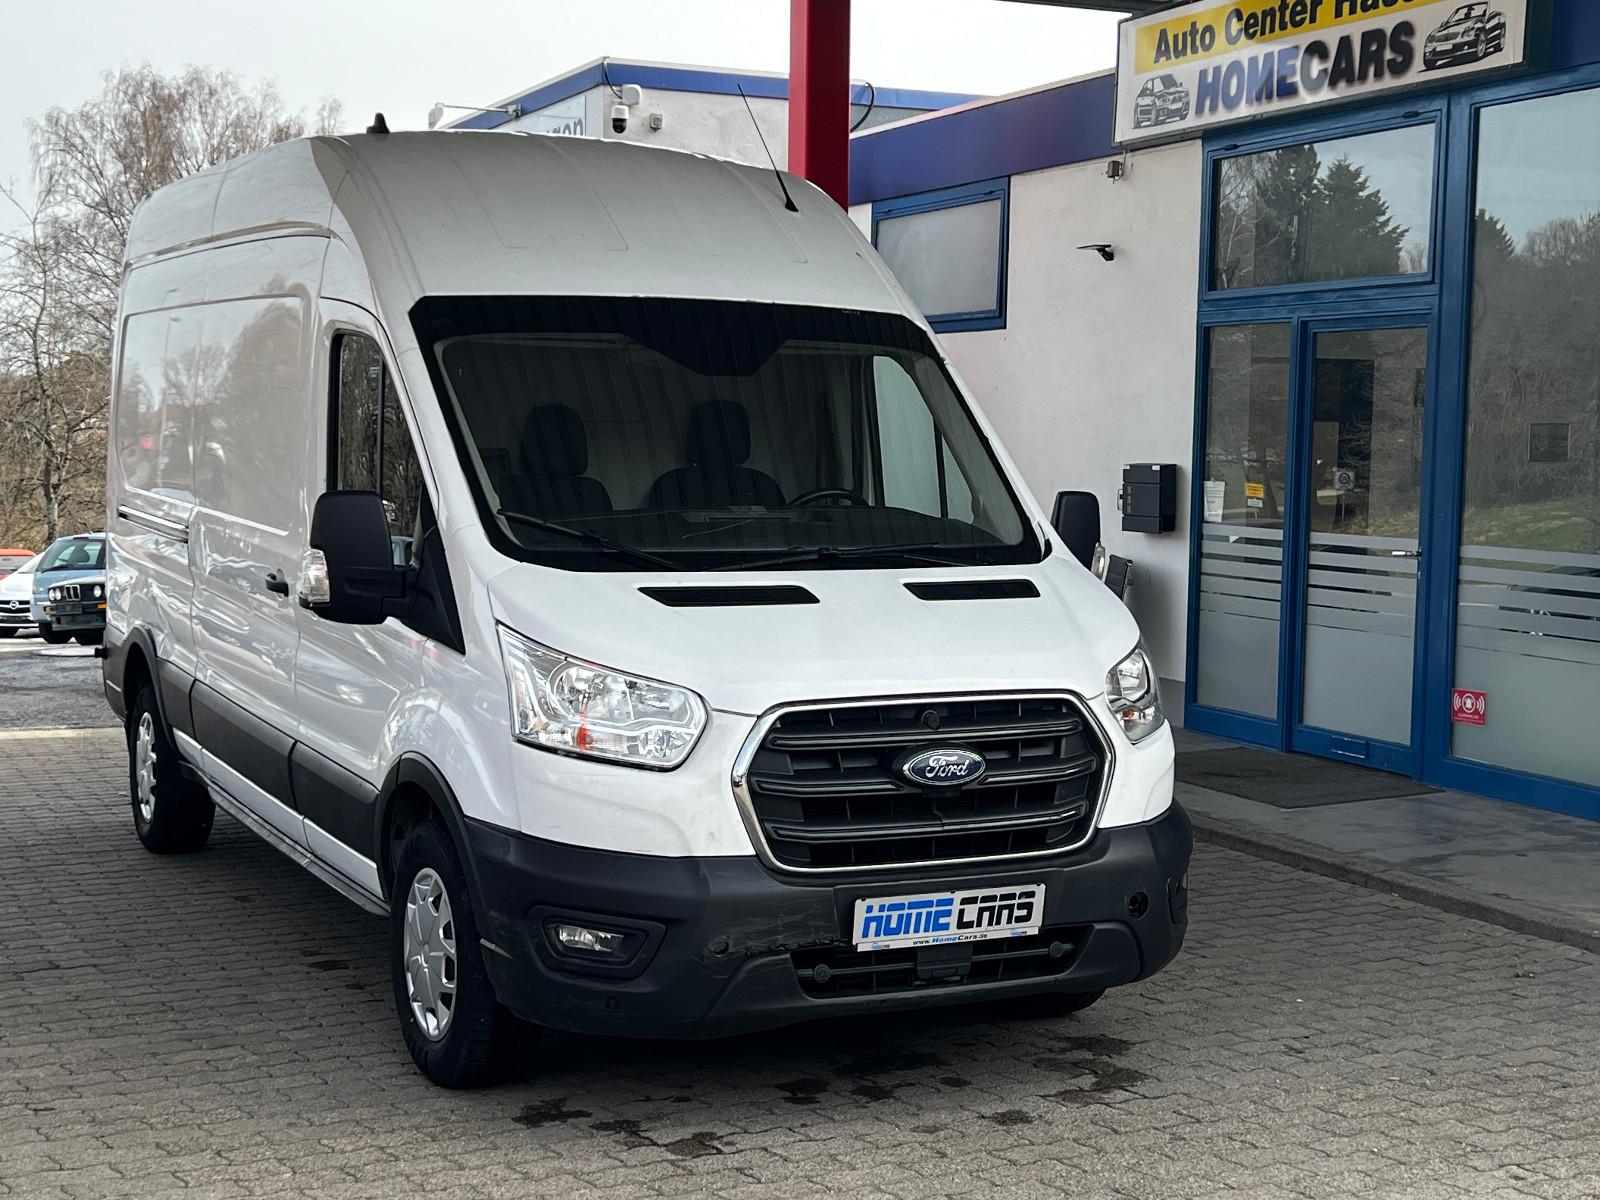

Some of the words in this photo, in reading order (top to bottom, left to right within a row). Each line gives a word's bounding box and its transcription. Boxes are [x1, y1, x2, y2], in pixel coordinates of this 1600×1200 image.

[1153, 22, 1216, 65] Auto
[1225, 0, 1324, 46] Center
[925, 755, 970, 778] Ford
[861, 897, 955, 938] HOME
[956, 890, 1037, 930] CARS
[912, 932, 988, 946] www.HomeCars.de
